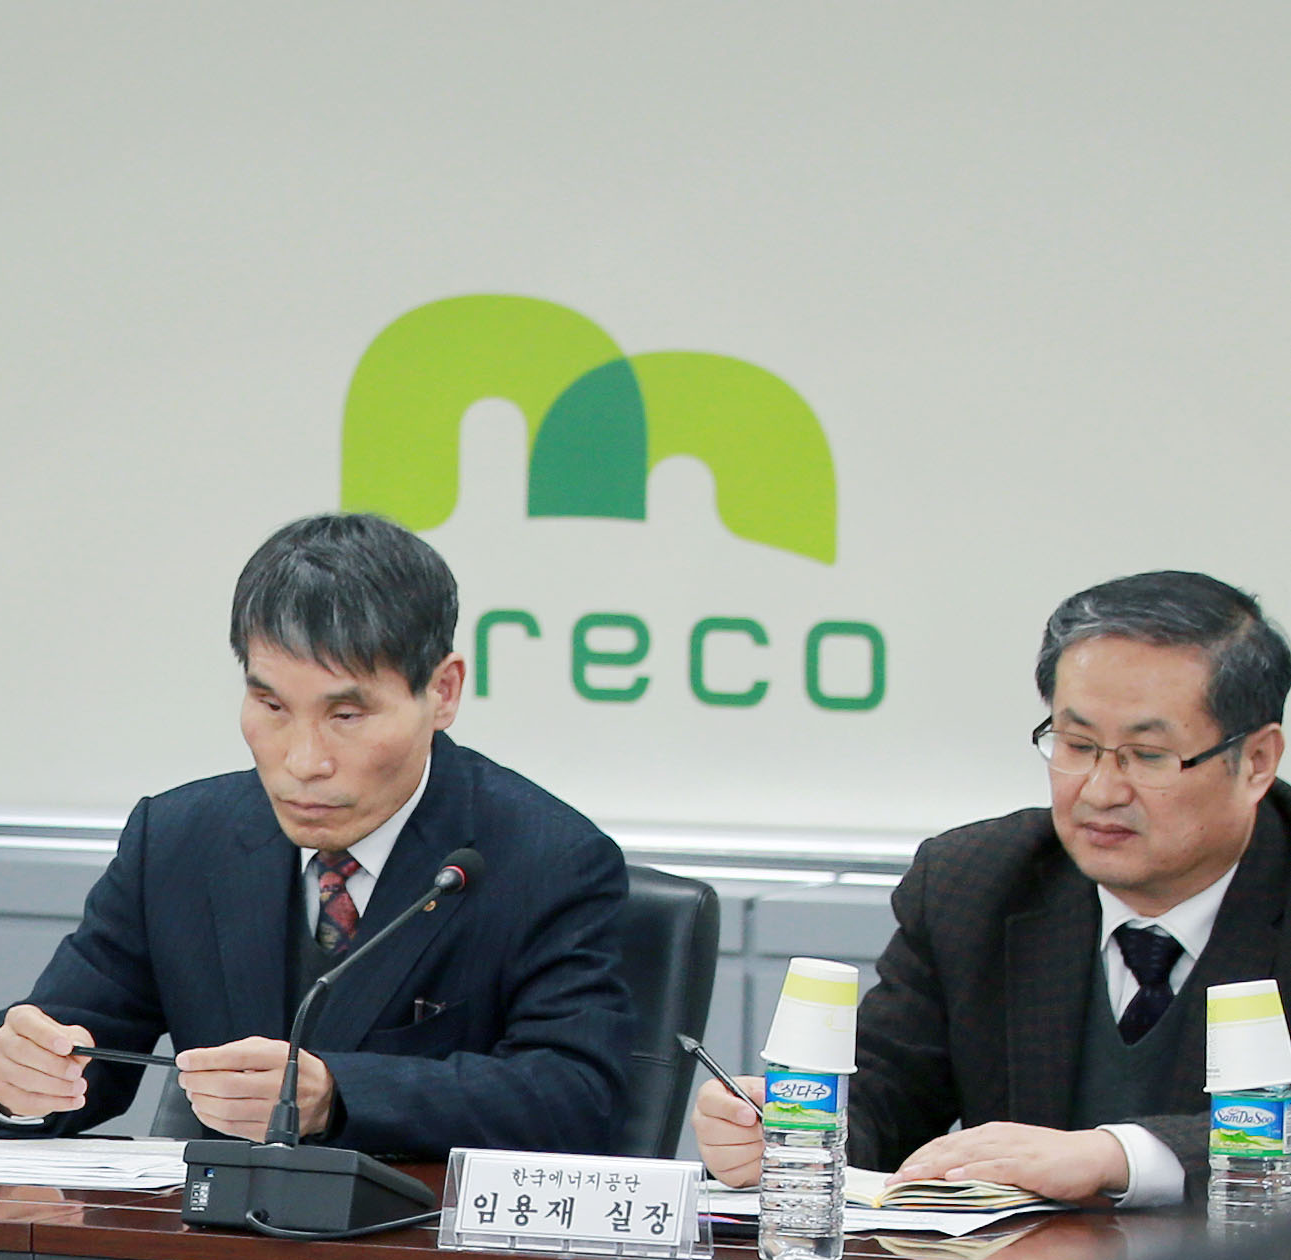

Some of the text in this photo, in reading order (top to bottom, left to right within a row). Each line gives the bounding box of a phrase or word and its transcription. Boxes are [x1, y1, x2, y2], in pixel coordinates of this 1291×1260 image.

[512, 1167, 642, 1194] 한국에너지공단
[473, 1191, 674, 1236] 임용재 실장
